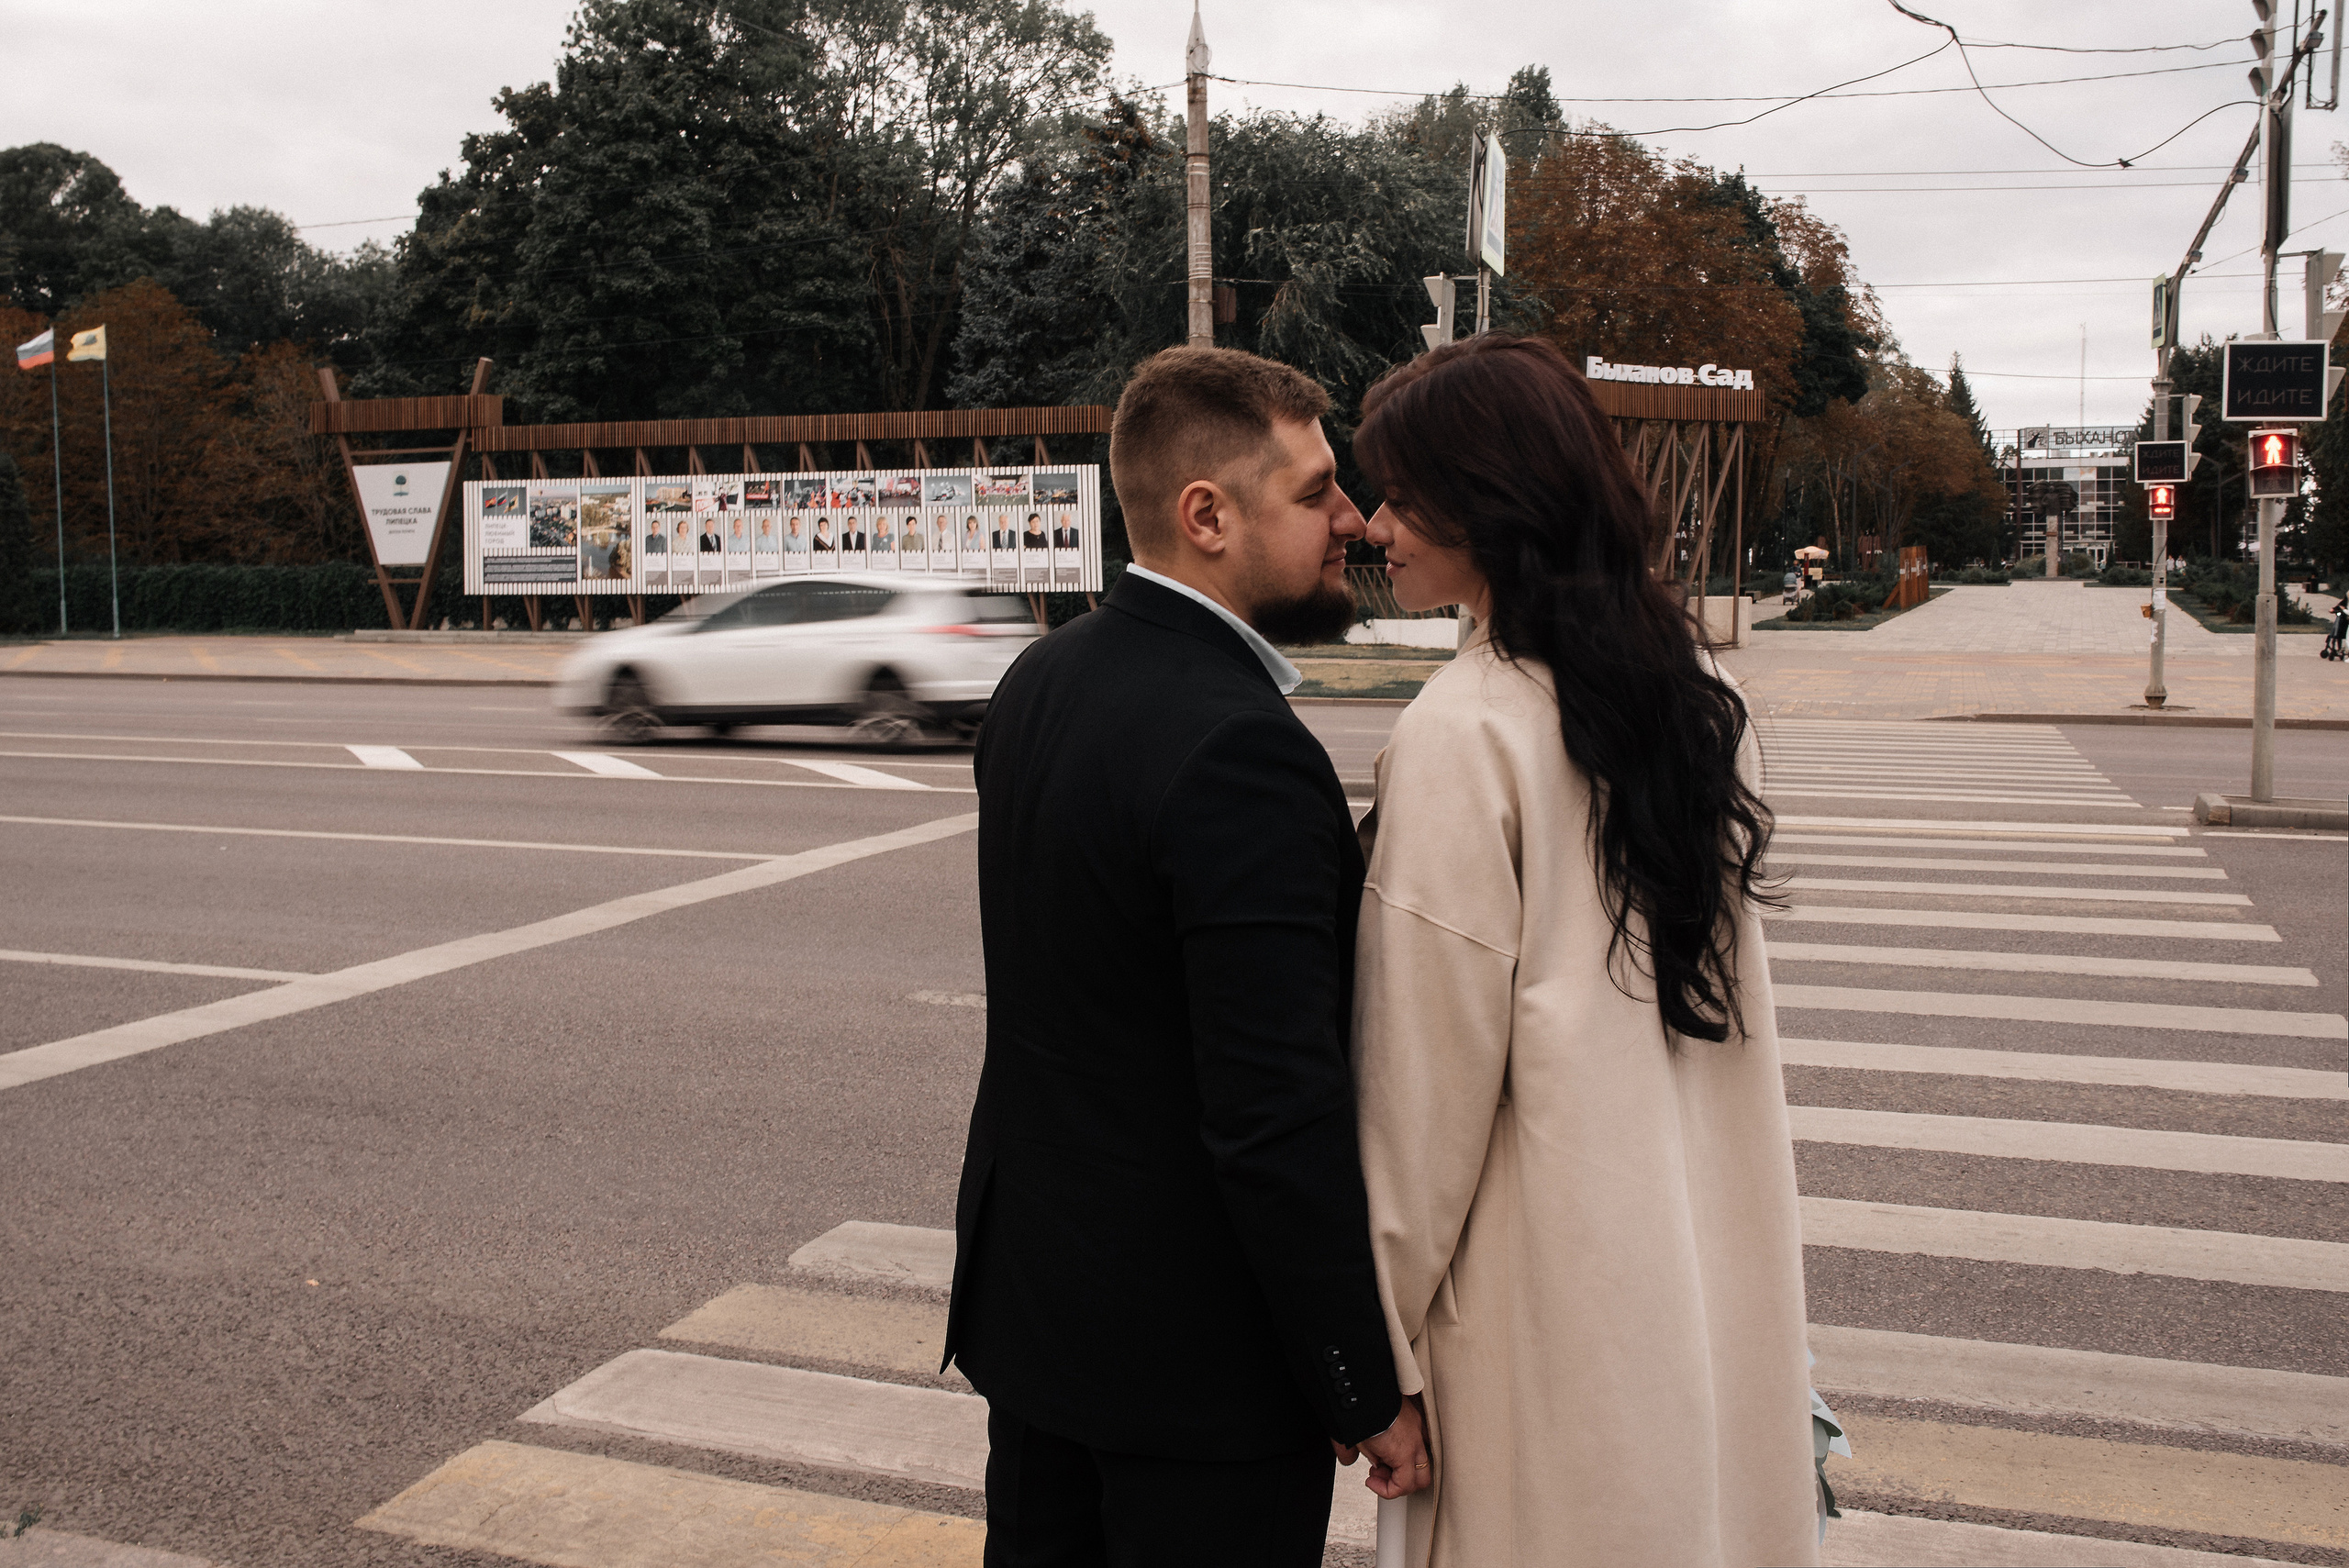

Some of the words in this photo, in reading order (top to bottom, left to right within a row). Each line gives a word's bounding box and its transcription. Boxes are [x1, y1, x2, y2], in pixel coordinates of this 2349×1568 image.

[2237, 356, 2314, 373] ЖДИТЕ
[1586, 355, 1695, 385] Быханов
[1698, 363, 1754, 391] Сад
[2237, 389, 2313, 405] ИДИТЕ
[2053, 429, 2136, 446] БЫХАНО
[2142, 449, 2180, 459] ЖДИТЕ
[2142, 464, 2180, 475] ИДИТЕ
[372, 507, 406, 516] ТРУДОВАЯ
[407, 506, 431, 515] СЛАВА
